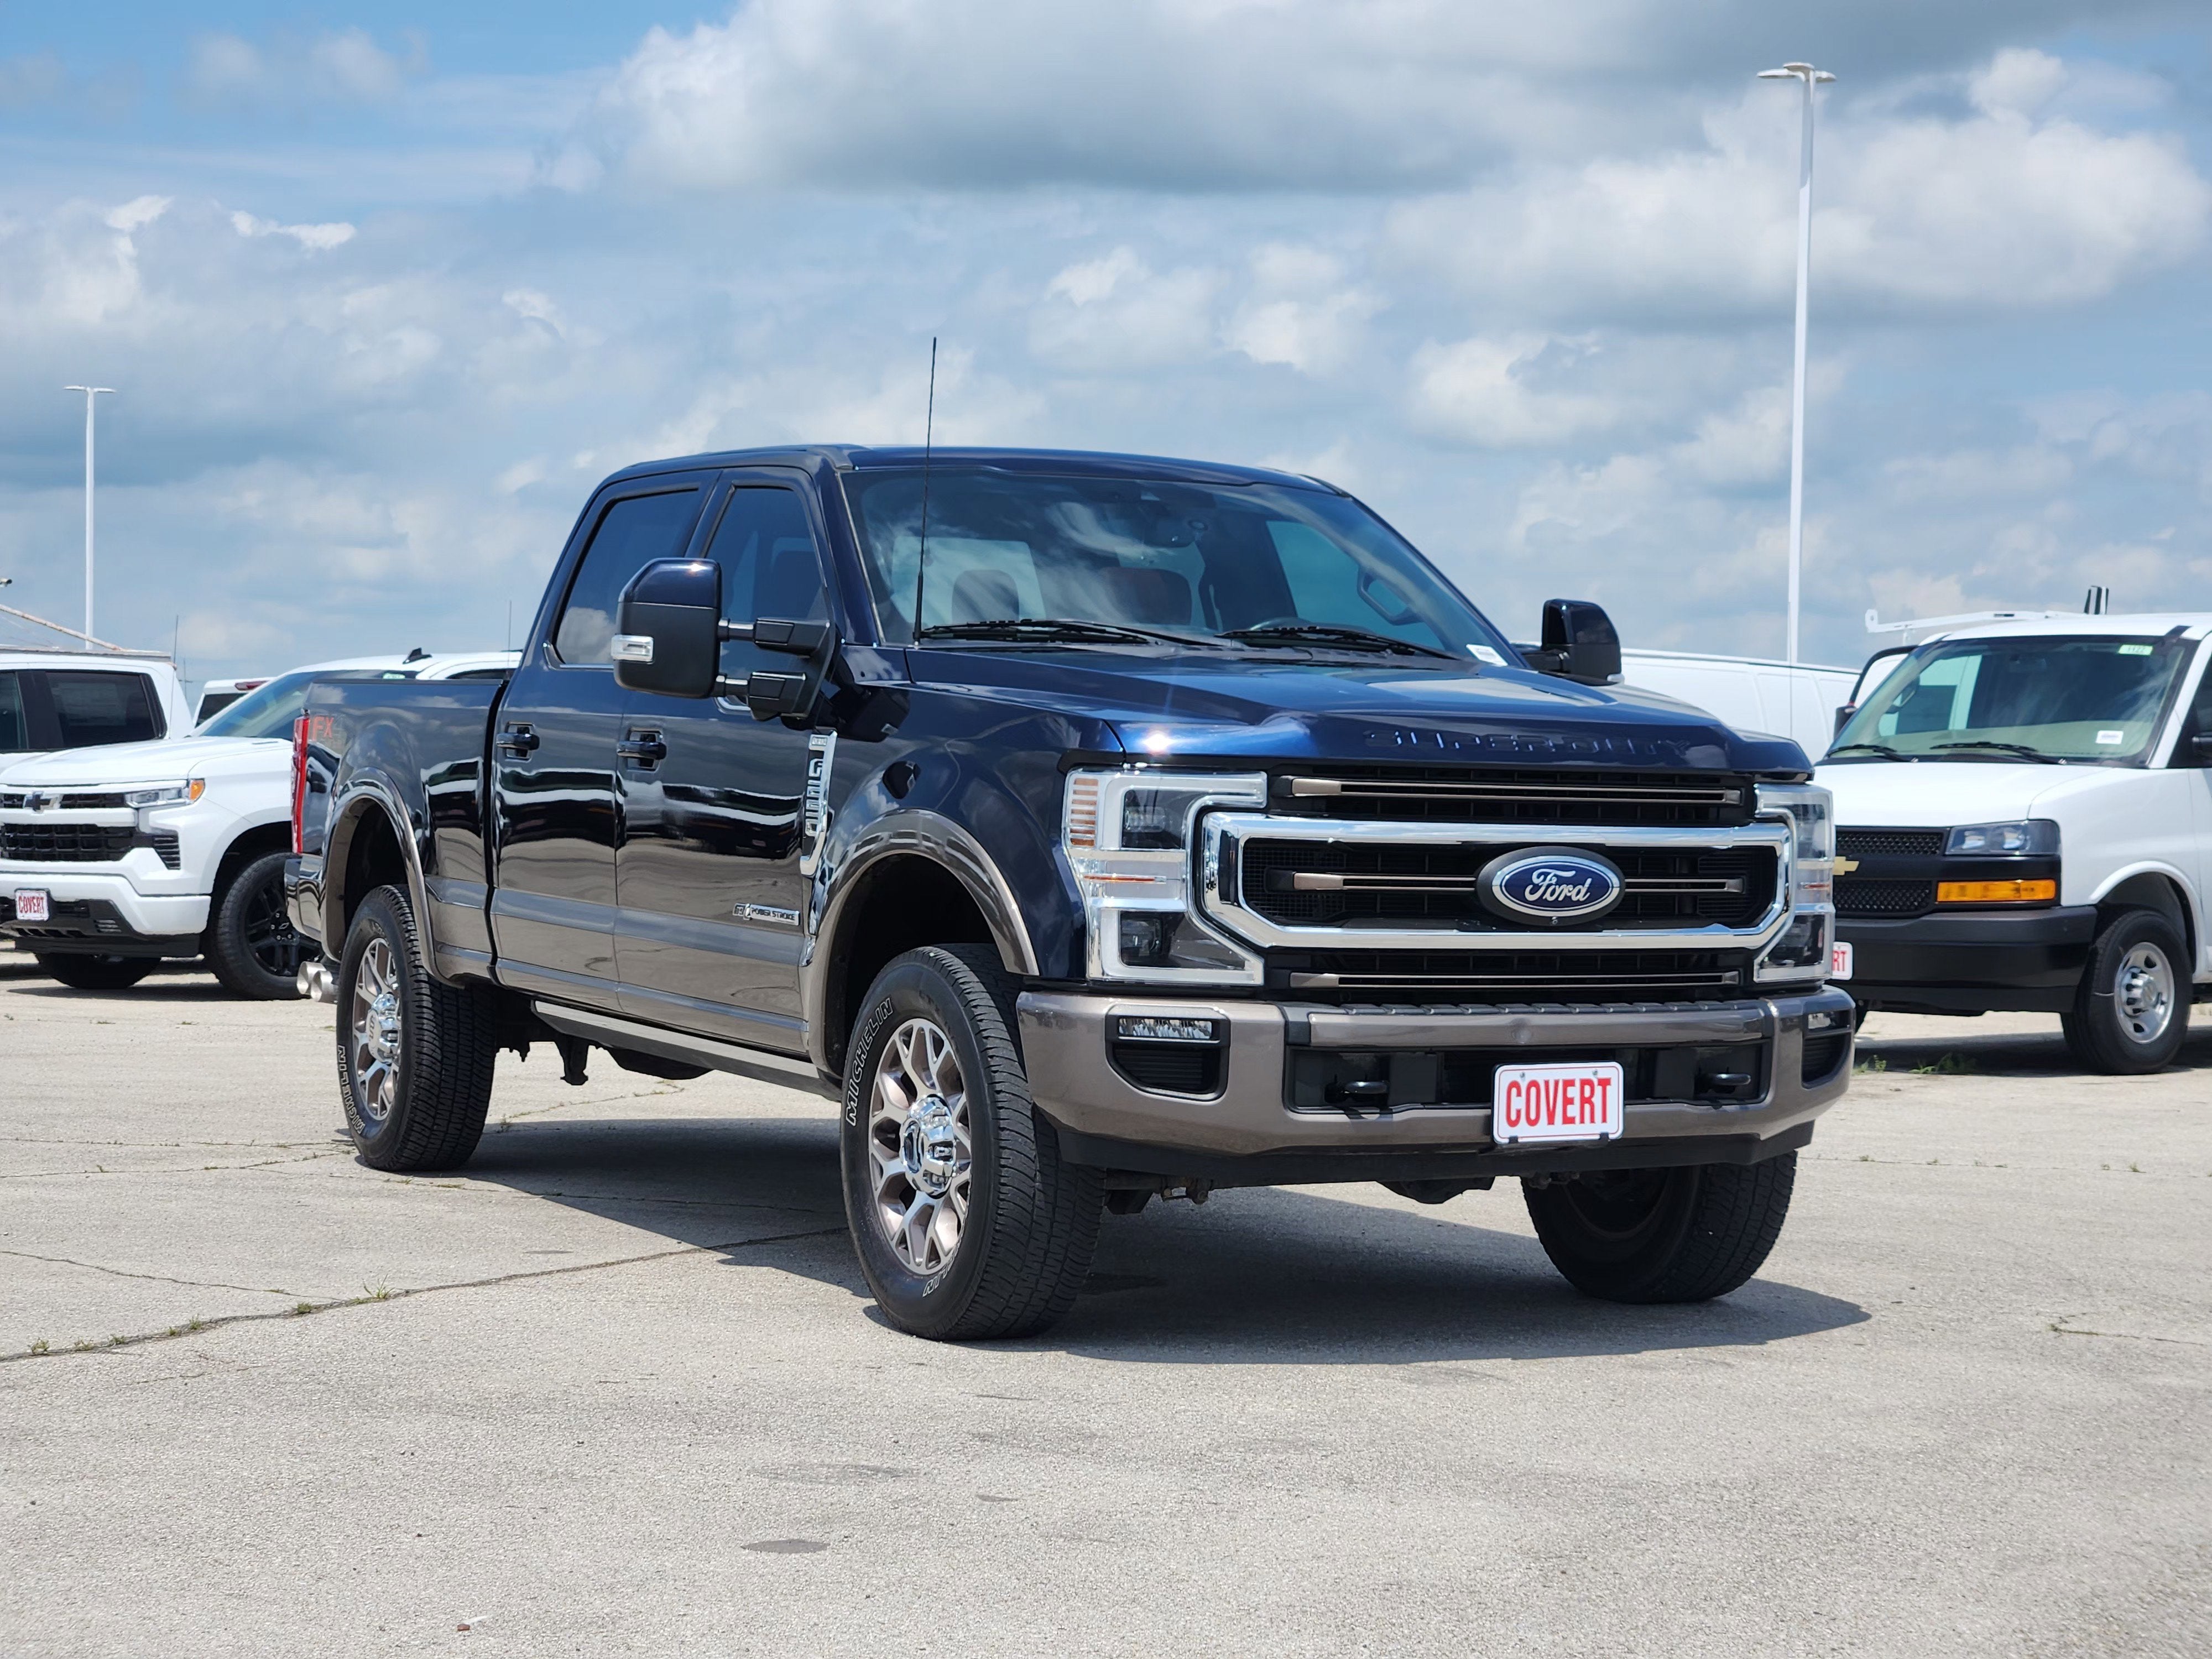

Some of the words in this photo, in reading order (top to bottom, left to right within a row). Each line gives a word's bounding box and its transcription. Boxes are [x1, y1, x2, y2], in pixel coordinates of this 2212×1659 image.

[18, 895, 45, 914] COVERT
[1525, 868, 1593, 901] Ford
[846, 997, 894, 1126] MICHELIN
[337, 1045, 366, 1134] MICHELIN
[1505, 1077, 1611, 1128] COVERT
